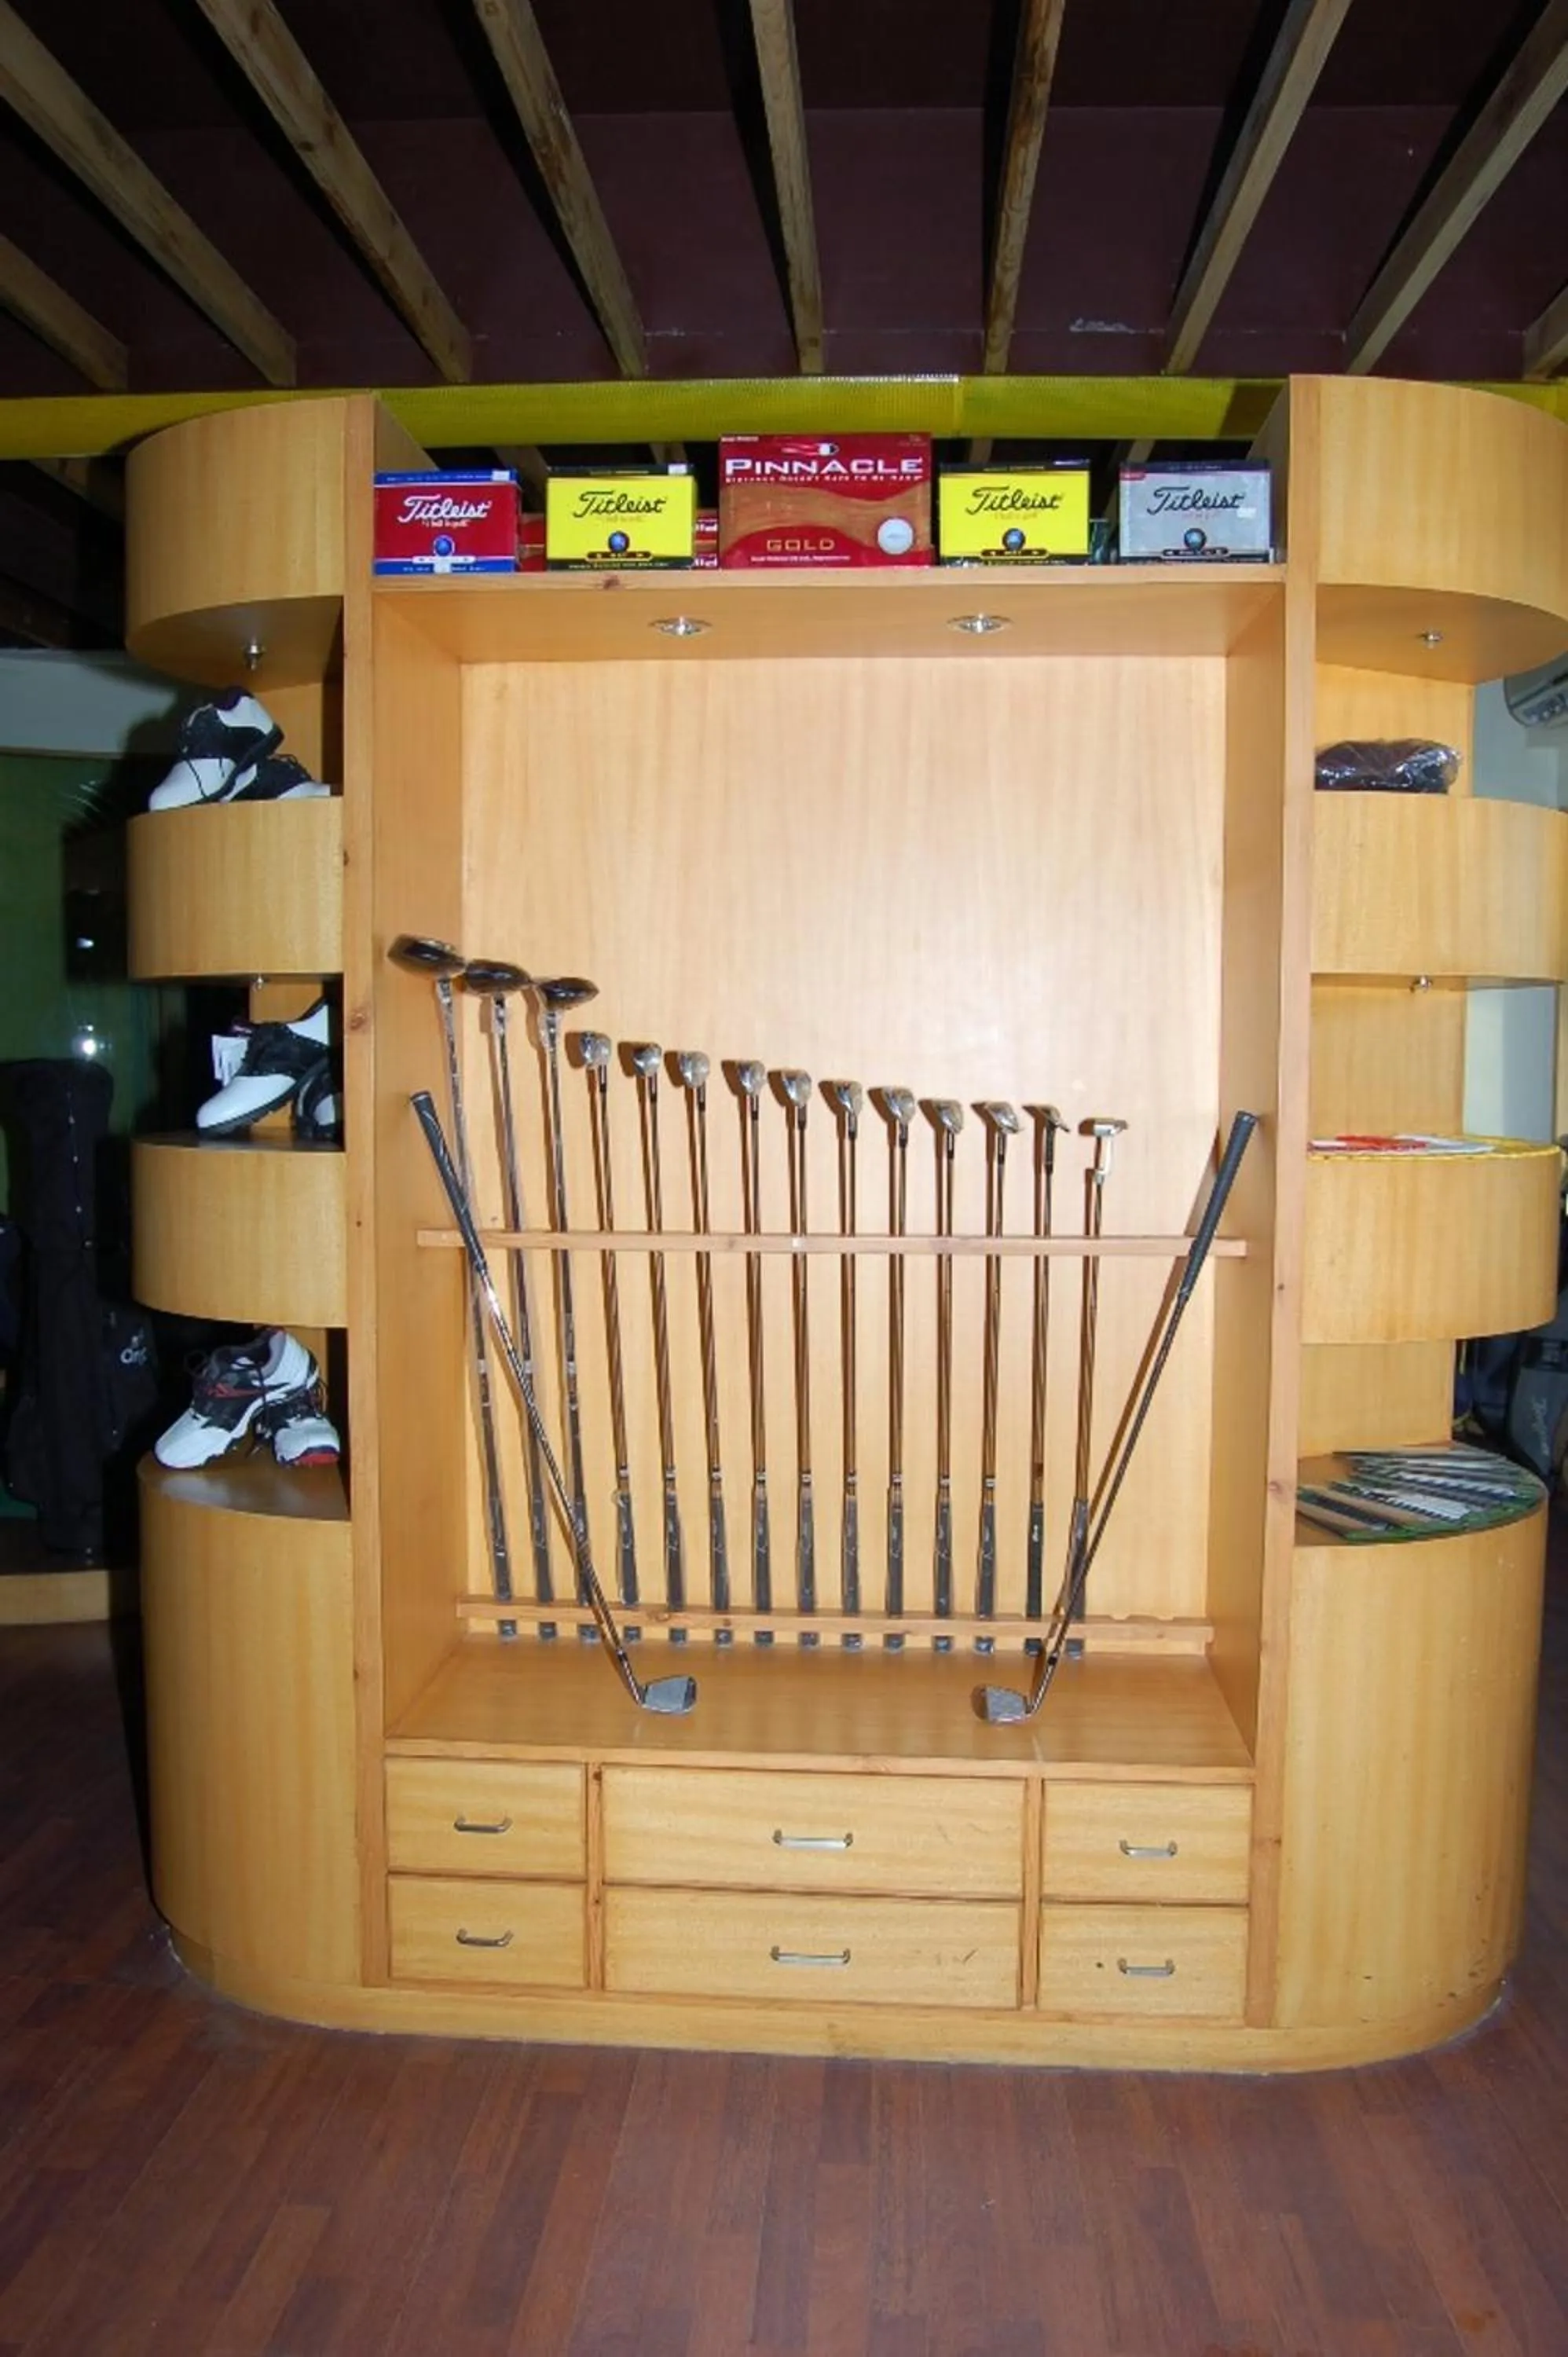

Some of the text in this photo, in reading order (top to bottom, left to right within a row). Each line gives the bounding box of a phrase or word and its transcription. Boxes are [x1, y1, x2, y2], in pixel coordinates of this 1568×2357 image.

[725, 458, 924, 475] PINNACLE
[397, 493, 493, 523] Titleist
[573, 490, 667, 518] Titleist
[965, 486, 1063, 515] Titleist
[1147, 486, 1244, 515] Titleist
[766, 539, 835, 552] GOLD
